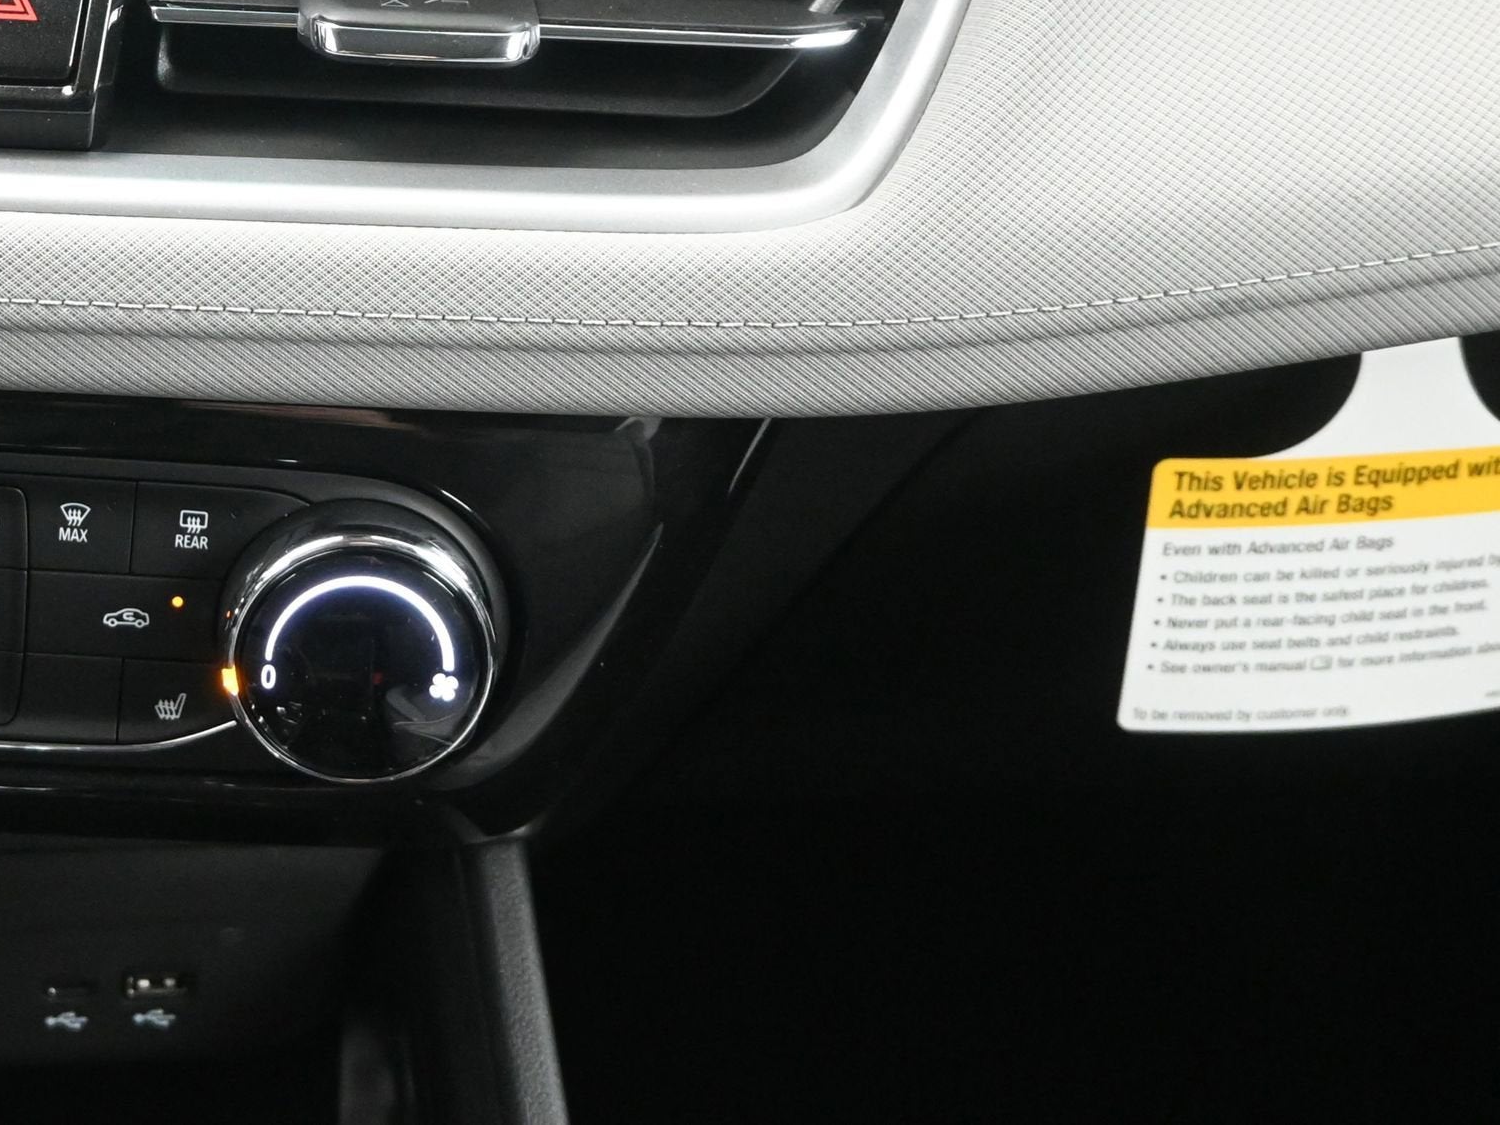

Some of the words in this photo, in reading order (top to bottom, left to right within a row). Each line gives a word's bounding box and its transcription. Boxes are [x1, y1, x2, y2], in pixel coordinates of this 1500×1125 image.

[1174, 471, 1224, 492] This
[1232, 469, 1318, 491] Vehicle
[1326, 467, 1345, 487] is
[1353, 457, 1459, 485] Equipped
[1168, 497, 1288, 519] Advanced
[1295, 494, 1328, 516] Air
[1336, 493, 1395, 517] Bags
[58, 526, 89, 544] MAX
[174, 533, 209, 551] REAR
[1162, 541, 1202, 557] Even
[1208, 540, 1242, 557] with
[1246, 538, 1325, 554] Advanced
[1329, 537, 1351, 552] Air
[1356, 535, 1394, 551] Bags
[1172, 569, 1238, 585] Children
[1243, 571, 1271, 583] can
[1276, 567, 1295, 583] be
[1299, 564, 1340, 581] killed
[1345, 567, 1361, 579] or
[1171, 591, 1197, 607] The
[1202, 592, 1237, 607] back
[1242, 592, 1273, 606] seat
[1294, 590, 1317, 604] the
[1166, 614, 1209, 630] Never
[1162, 636, 1217, 653] Always
